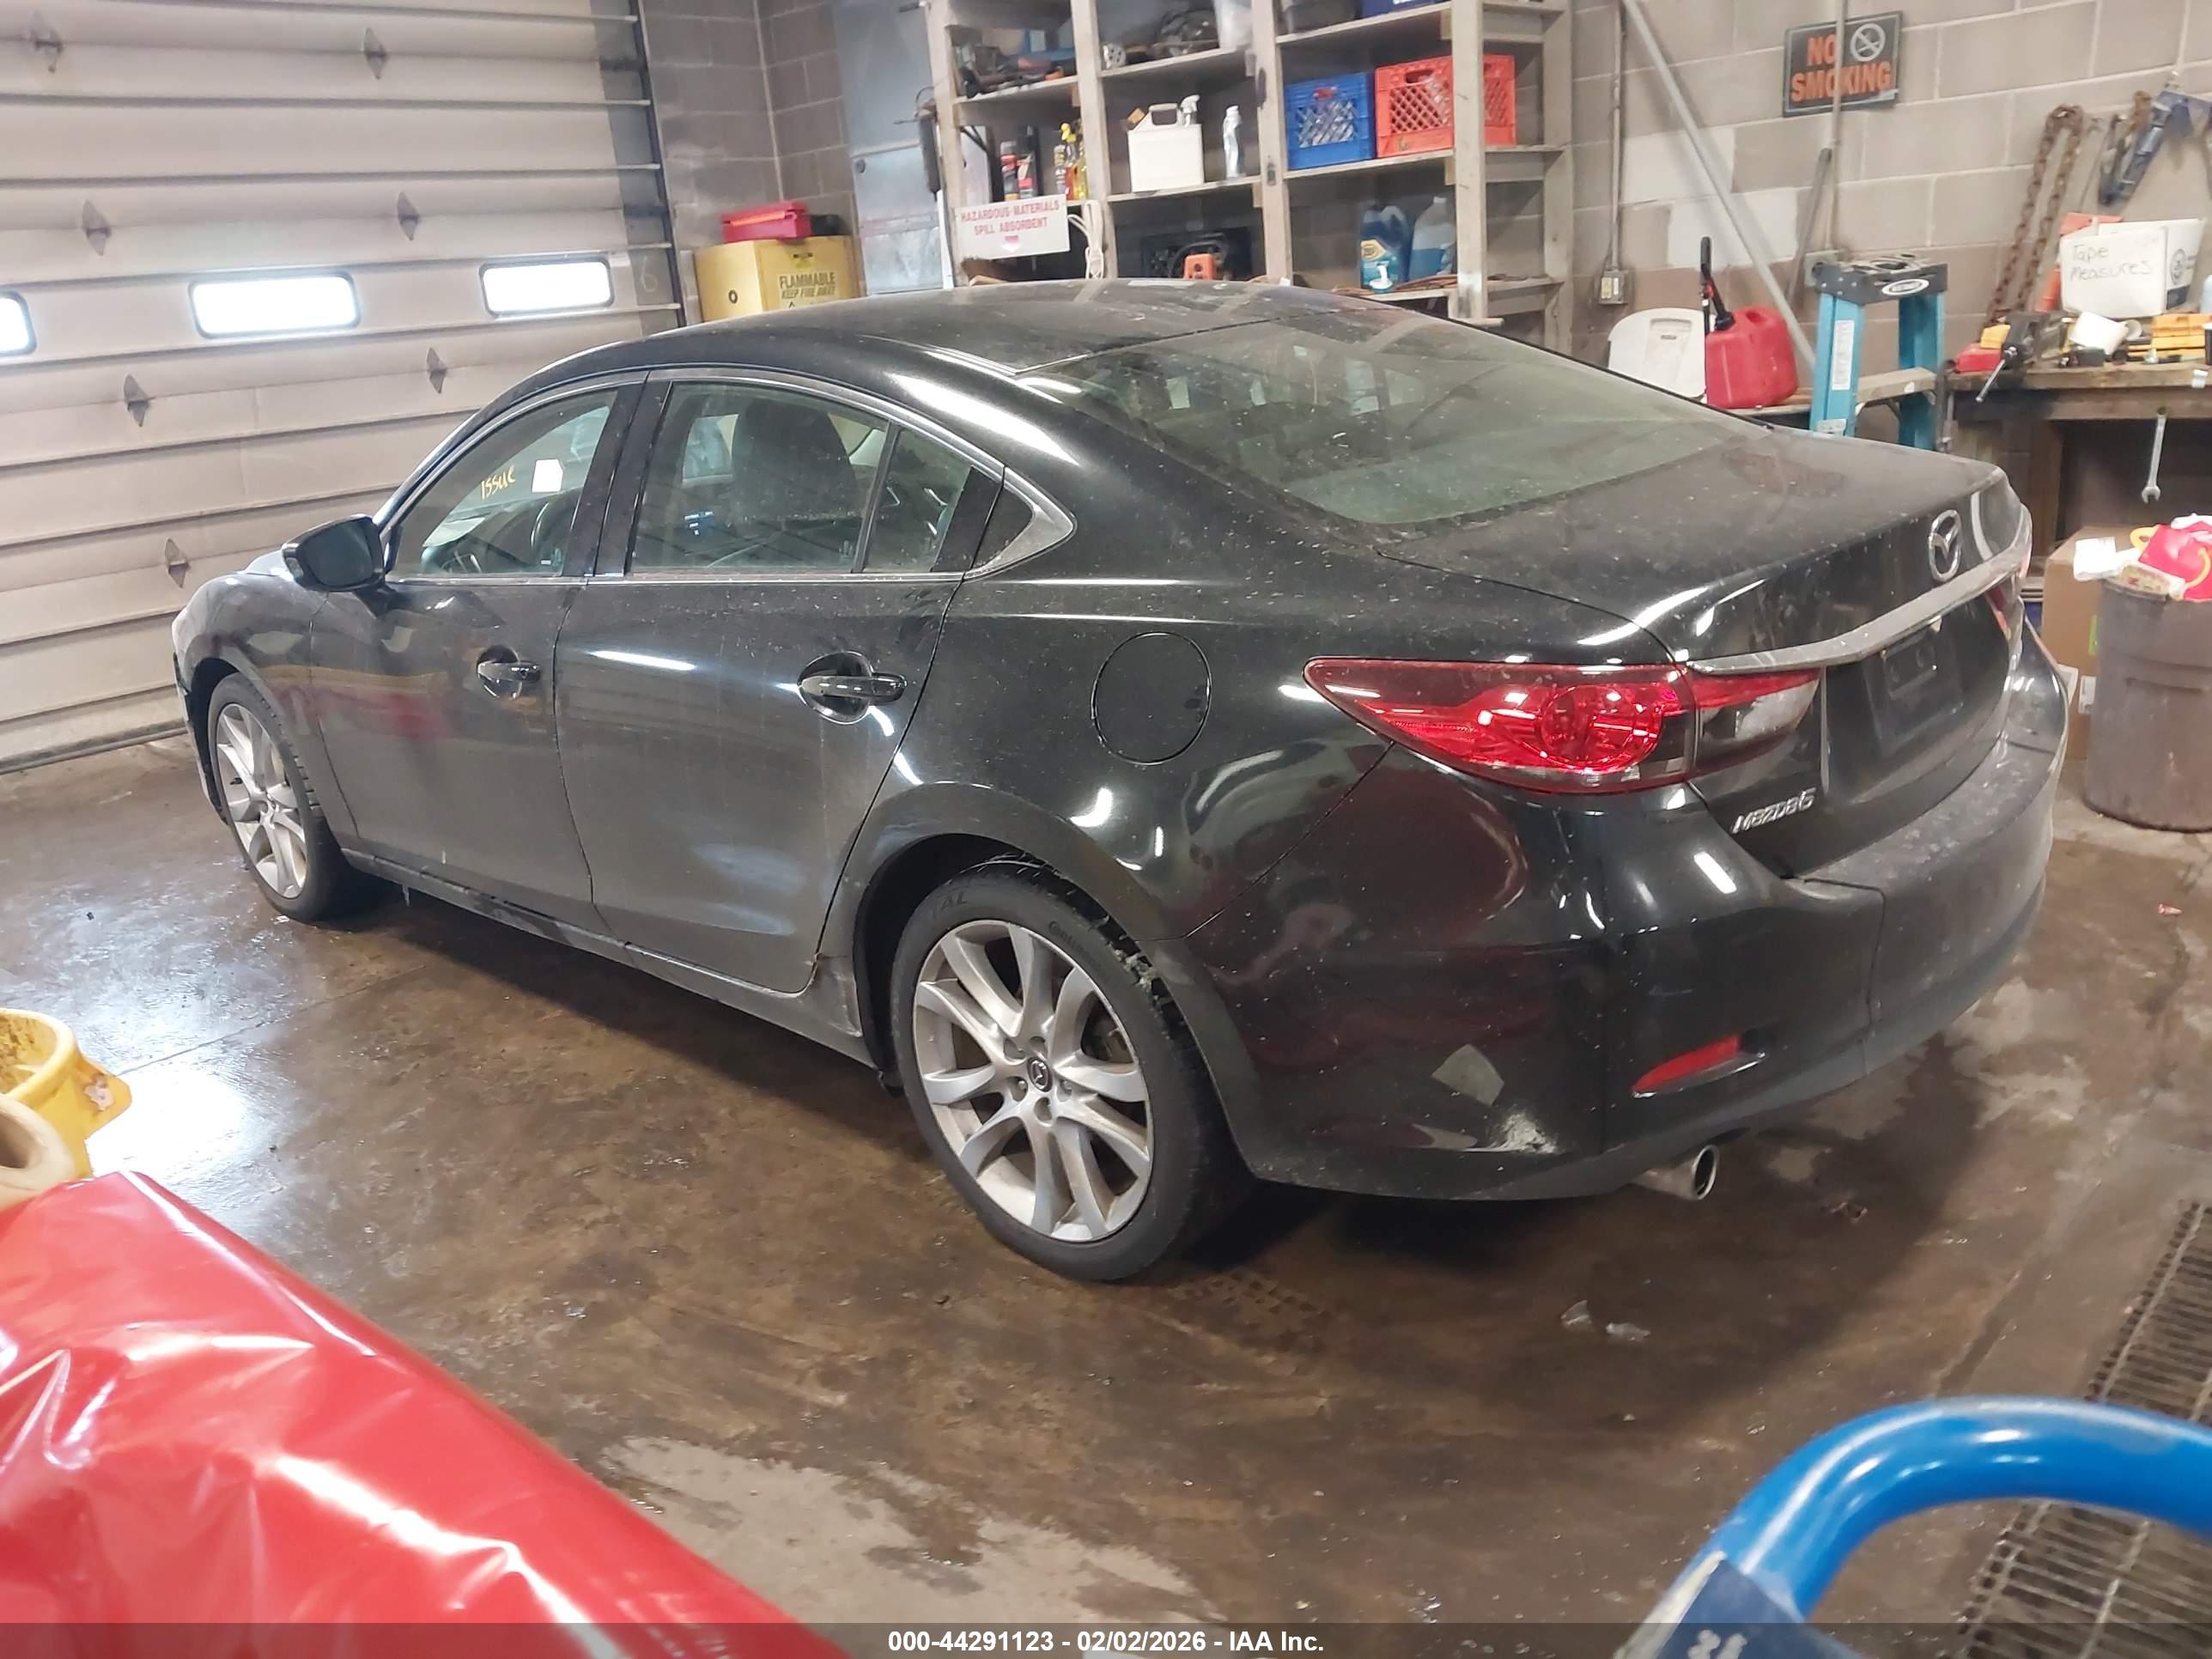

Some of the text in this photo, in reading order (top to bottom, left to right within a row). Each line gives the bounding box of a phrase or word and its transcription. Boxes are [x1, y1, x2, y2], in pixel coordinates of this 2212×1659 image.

[1806, 33, 1836, 67] NO
[1790, 61, 1892, 102] SMOKING
[961, 199, 1060, 222] HAZARDOUS MATERIALS
[974, 216, 1048, 235] SPILL ABSORBENT
[2073, 244, 2110, 263] Tape
[779, 271, 836, 289] FLAMMABLE
